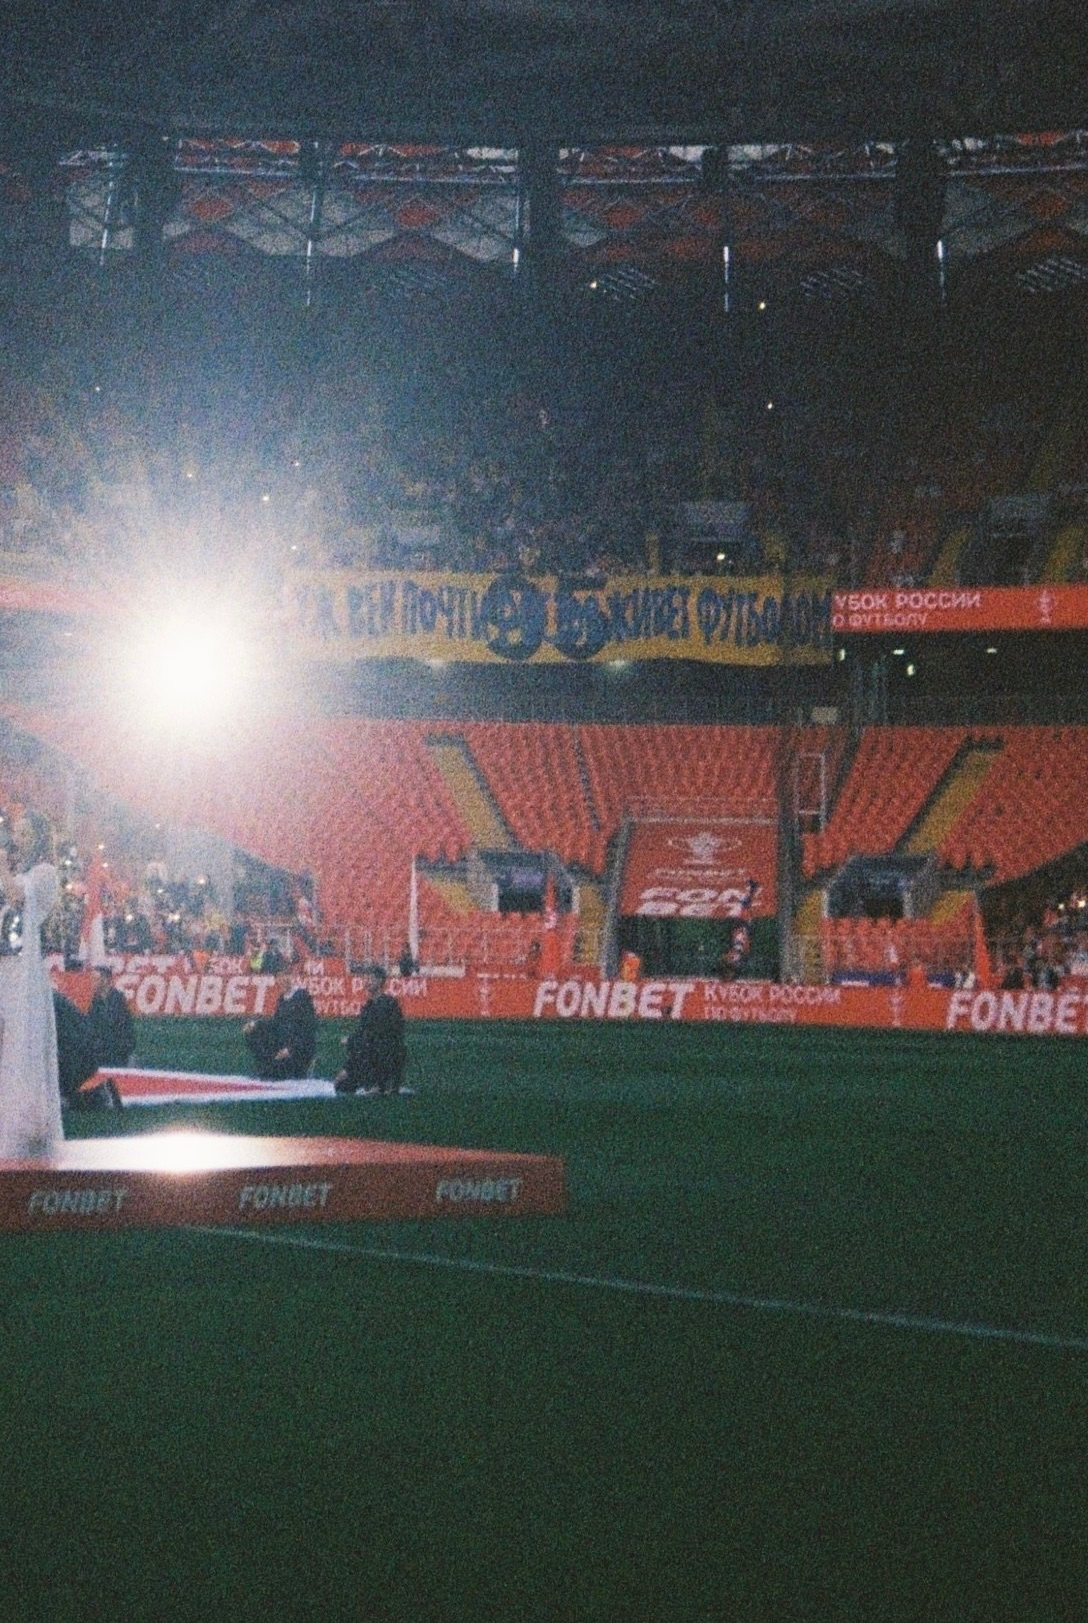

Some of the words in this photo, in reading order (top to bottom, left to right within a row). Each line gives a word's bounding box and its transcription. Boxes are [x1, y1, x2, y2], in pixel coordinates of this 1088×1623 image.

[833, 592, 888, 610] УБОК
[895, 592, 981, 609] РОССИИ
[848, 613, 928, 628] ФУТБОЛУ
[114, 975, 275, 1014] FONBET
[532, 980, 696, 1021] FONBET
[704, 983, 763, 1003] КУБОК
[769, 985, 842, 1005] РОССИИ
[945, 990, 1088, 1035] FONBE
[26, 1186, 130, 1218] FONBET
[239, 1181, 333, 1210] FONBET
[435, 1177, 523, 1202] FONBET
